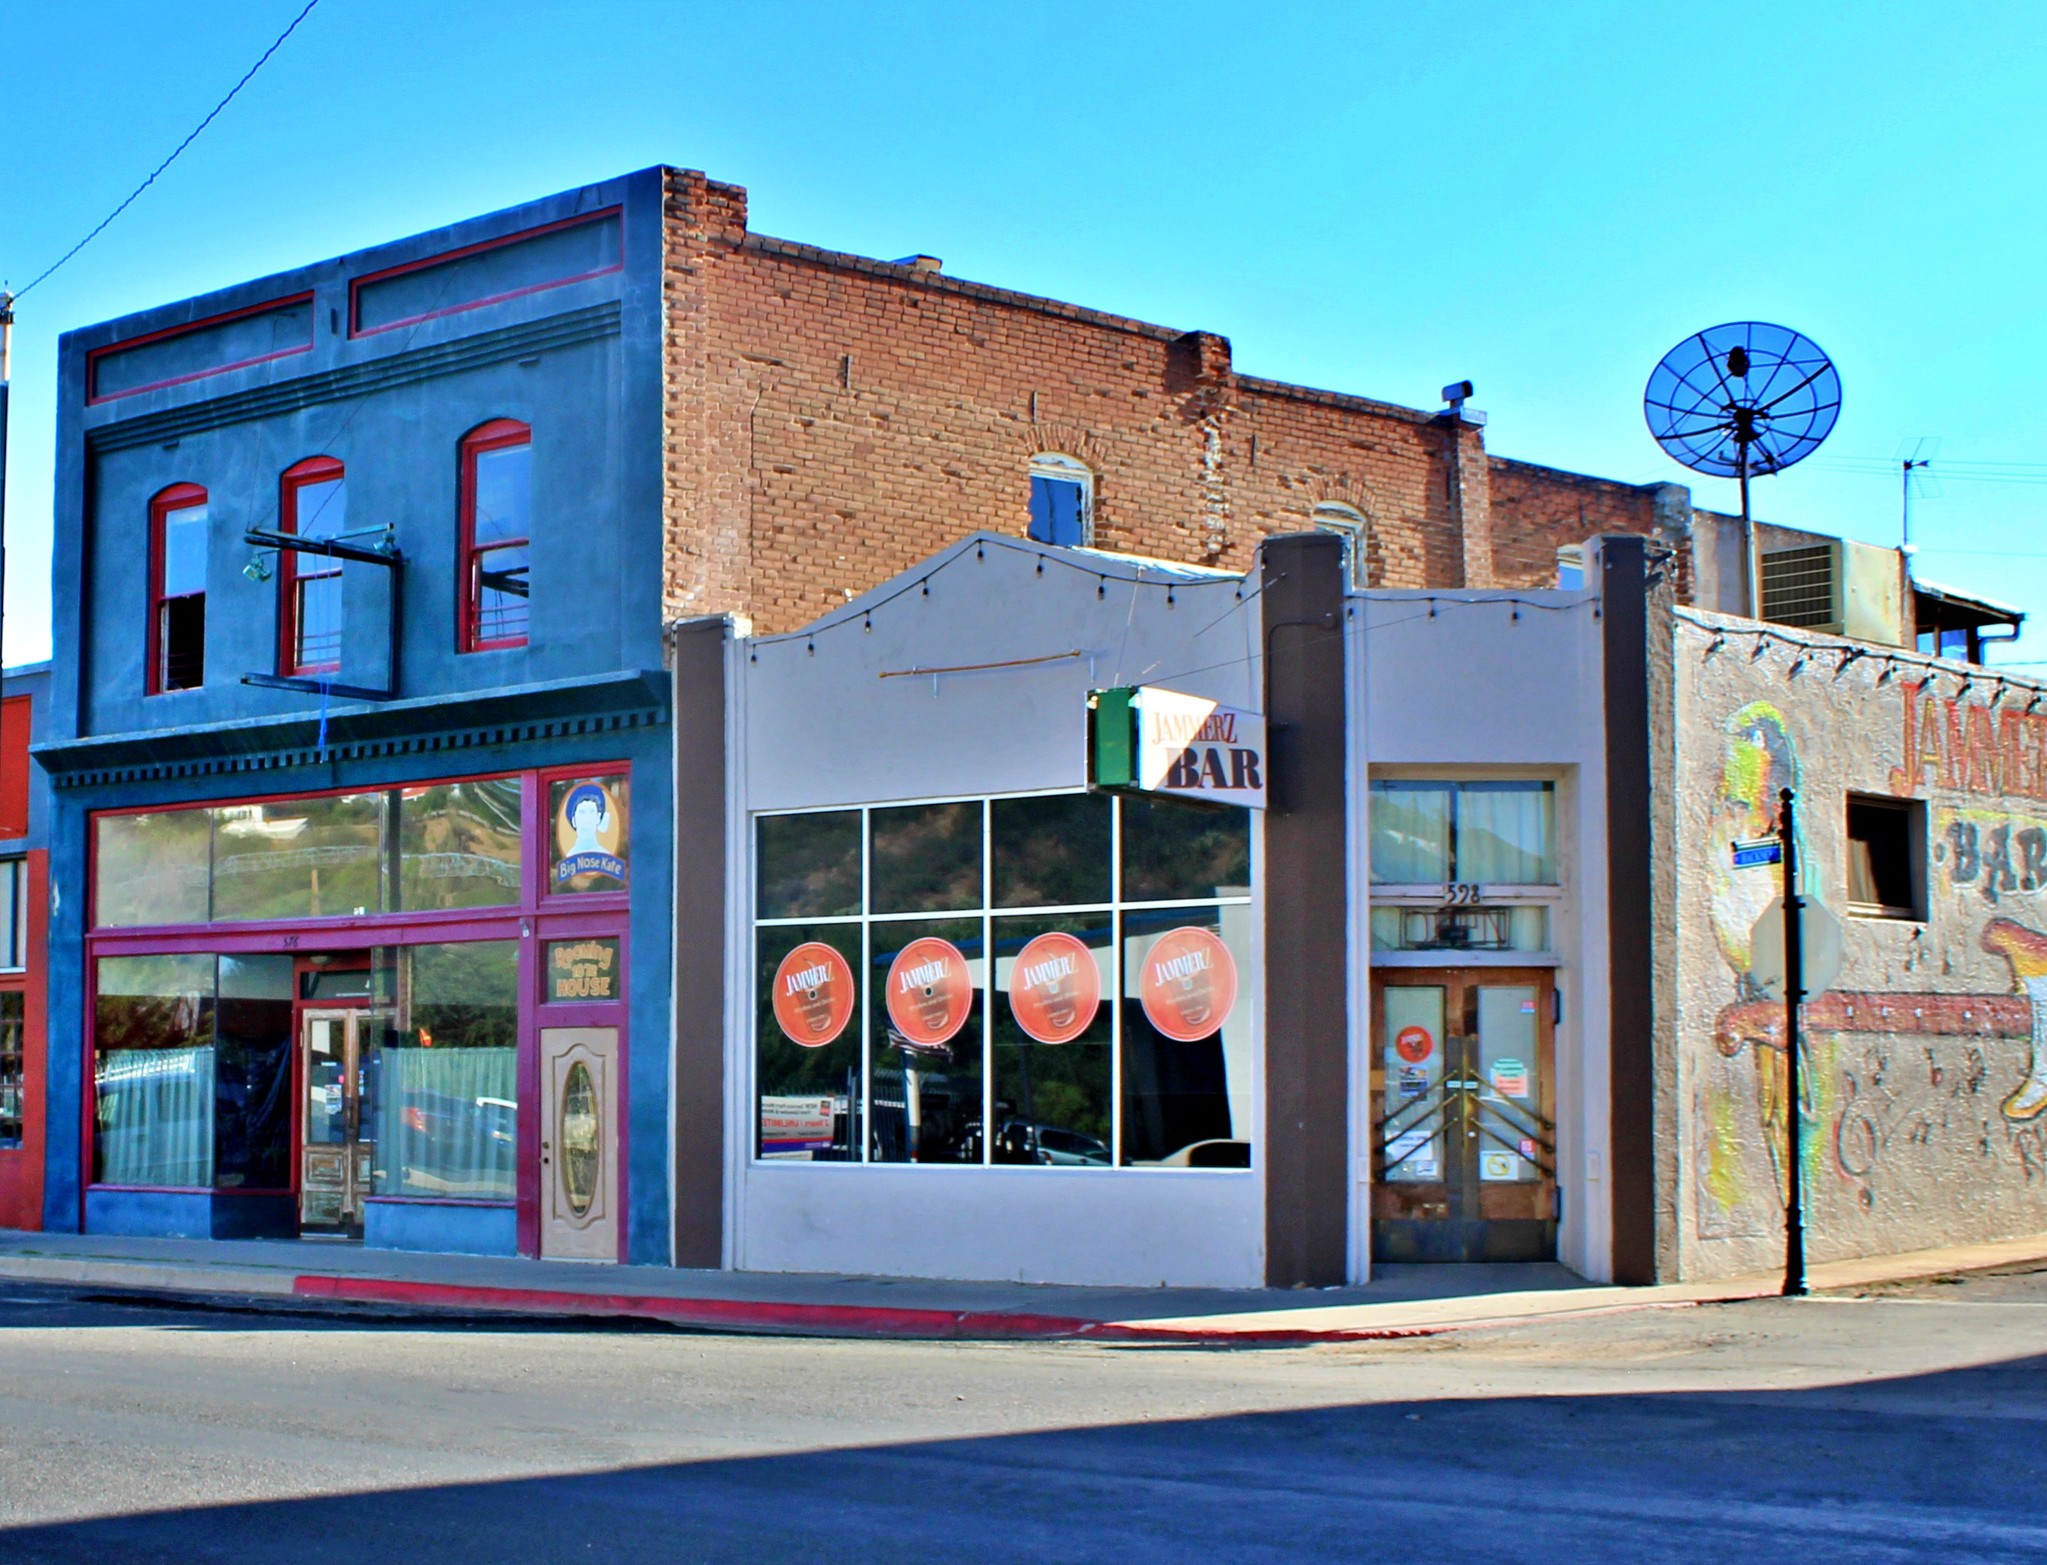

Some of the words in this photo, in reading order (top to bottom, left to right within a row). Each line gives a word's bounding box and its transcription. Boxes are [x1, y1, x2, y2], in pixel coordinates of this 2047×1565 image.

[1152, 712, 1237, 745] JAMMERZ
[1165, 747, 1263, 790] BAR
[560, 861, 576, 878] Big
[577, 857, 599, 870] Nose
[601, 857, 622, 874] Kate
[1946, 819, 2047, 904] BAR
[1447, 884, 1480, 904] 598
[786, 961, 835, 997] JAMMERZ
[900, 957, 952, 994] JAMMERZ
[1023, 951, 1079, 990] JAMMERZ
[1155, 947, 1214, 987] JAMMERZ
[556, 977, 611, 997] HOUSE
